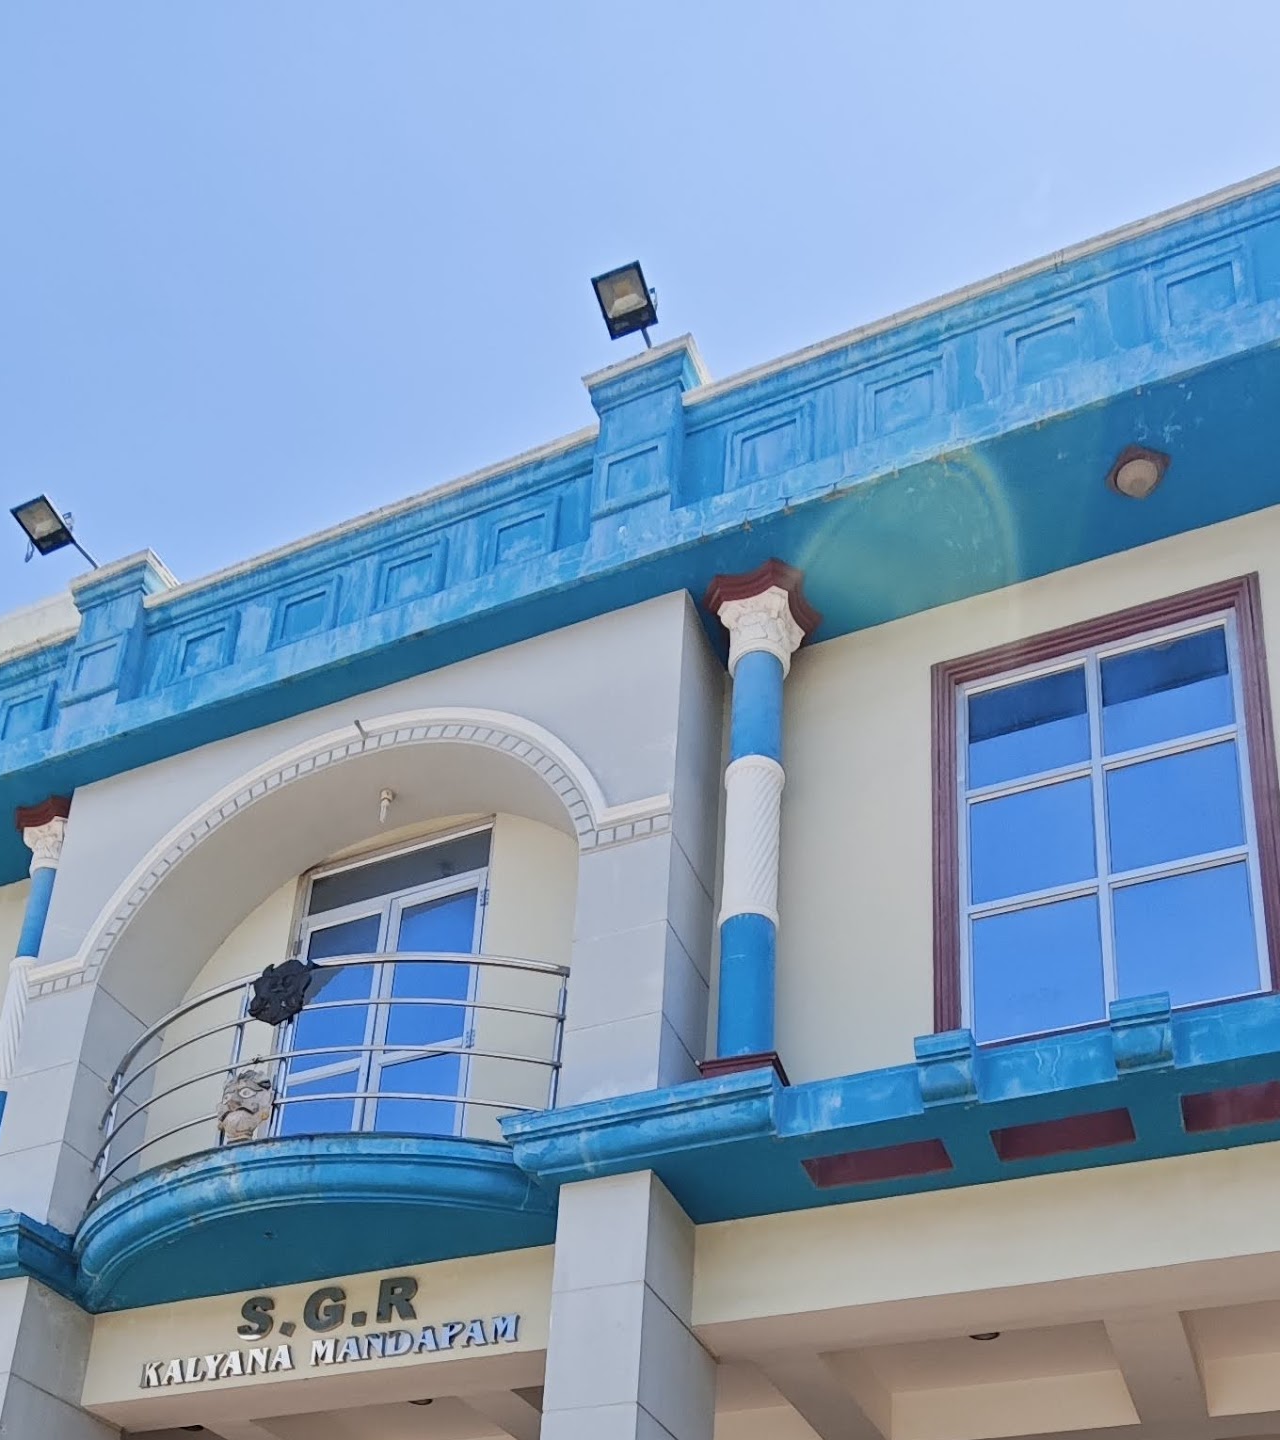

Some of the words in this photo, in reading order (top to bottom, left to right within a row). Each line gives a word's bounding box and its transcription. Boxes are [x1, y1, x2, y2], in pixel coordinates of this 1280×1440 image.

[237, 1276, 419, 1341] S.G.R
[139, 1344, 295, 1389] KALYANA
[309, 1313, 521, 1367] MANDAPAM
